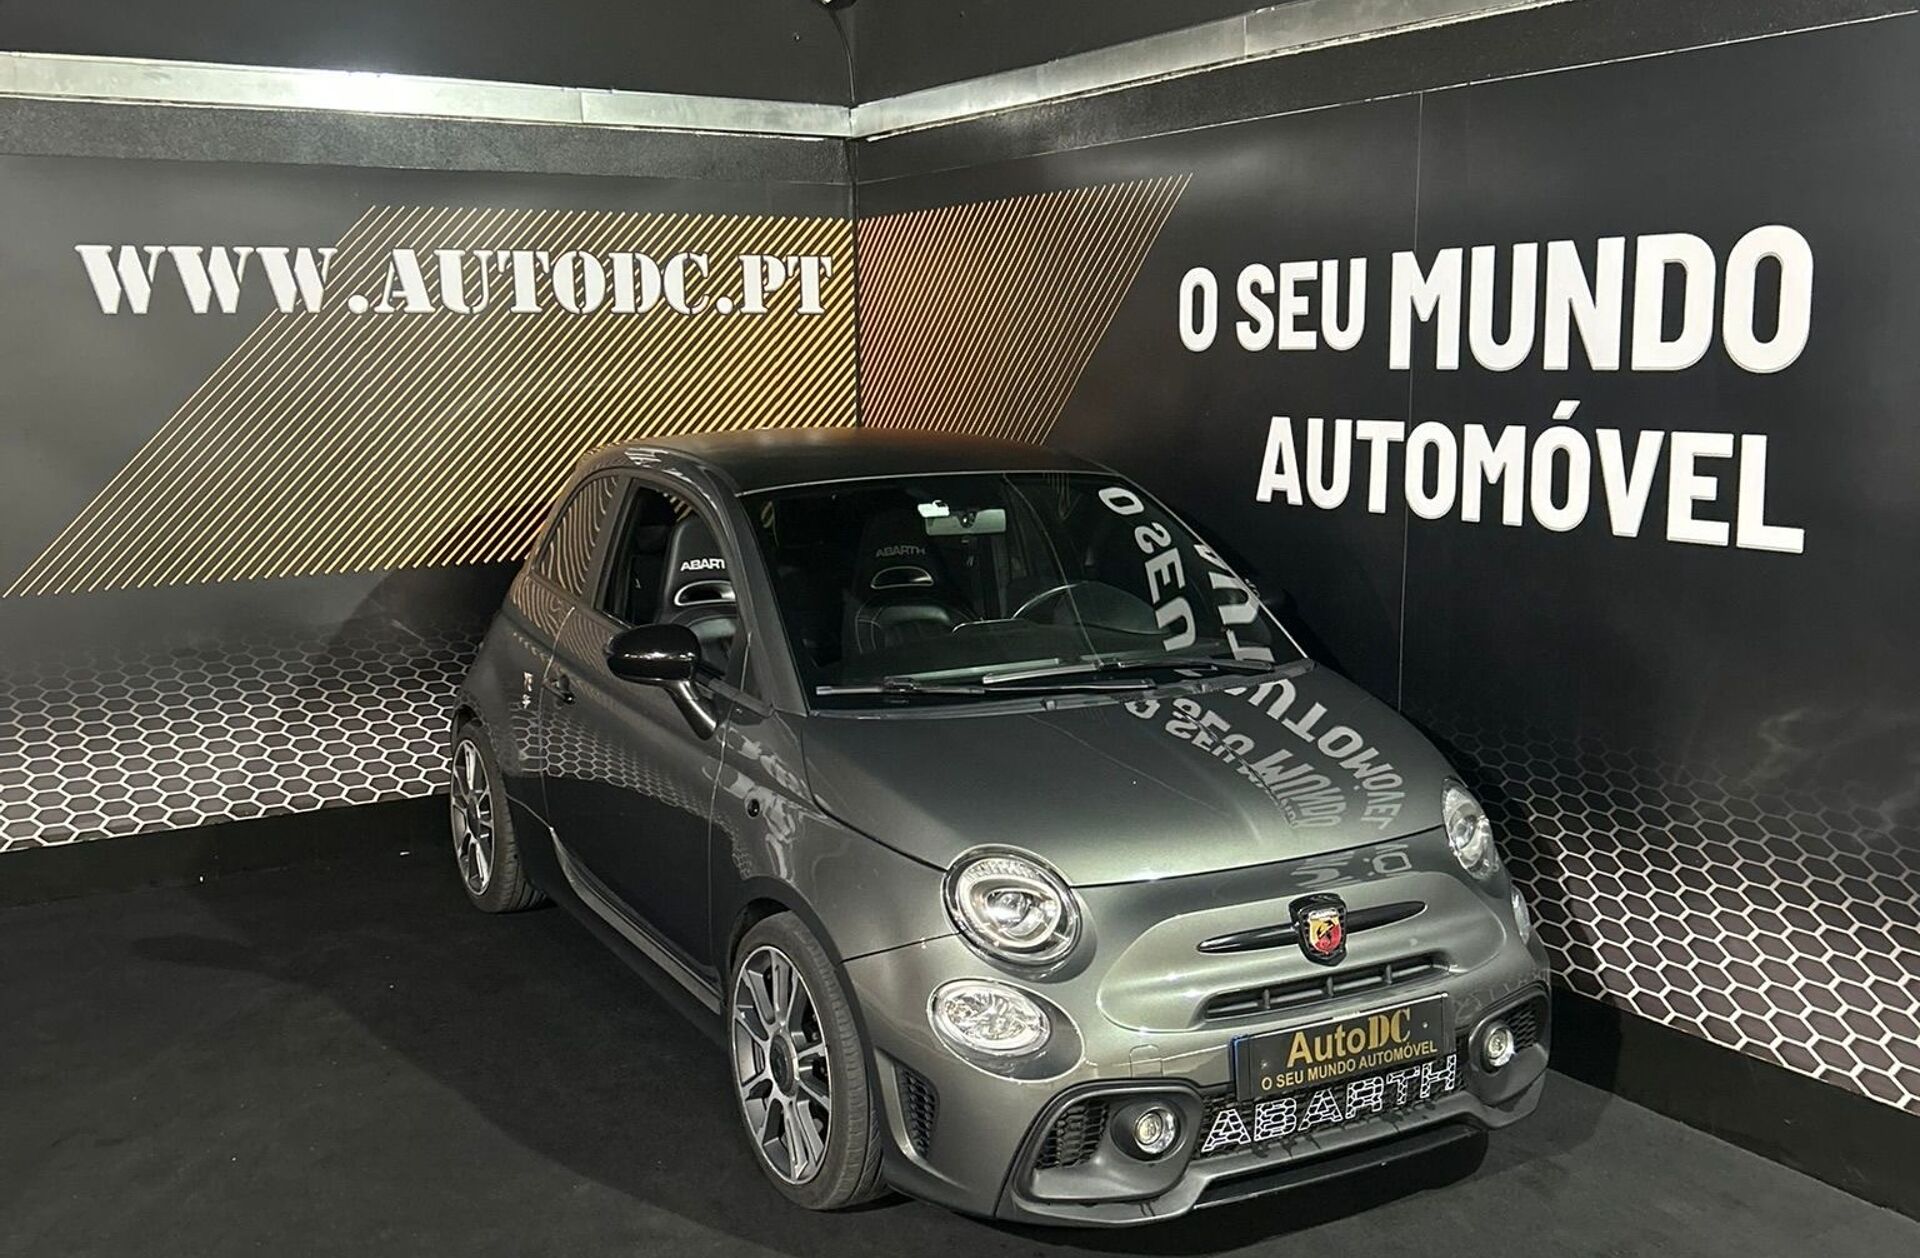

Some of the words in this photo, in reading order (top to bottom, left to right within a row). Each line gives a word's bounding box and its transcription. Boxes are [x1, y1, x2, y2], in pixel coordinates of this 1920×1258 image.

[1178, 265, 1219, 352] O
[1235, 257, 1367, 352] SEU
[1389, 224, 1814, 374] MUNDO
[1255, 399, 1806, 555] AUTOMÓVEL
[680, 558, 726, 572] ABART
[875, 544, 926, 558] ABARTH
[1261, 1077, 1273, 1091] O
[1276, 1070, 1304, 1088] SEU
[1308, 1057, 1356, 1081] MUNDO
[1359, 1040, 1438, 1069] AUTOMÓVEL
[1286, 1007, 1411, 1068] AutoDC
[1201, 1053, 1457, 1153] ABARTH
